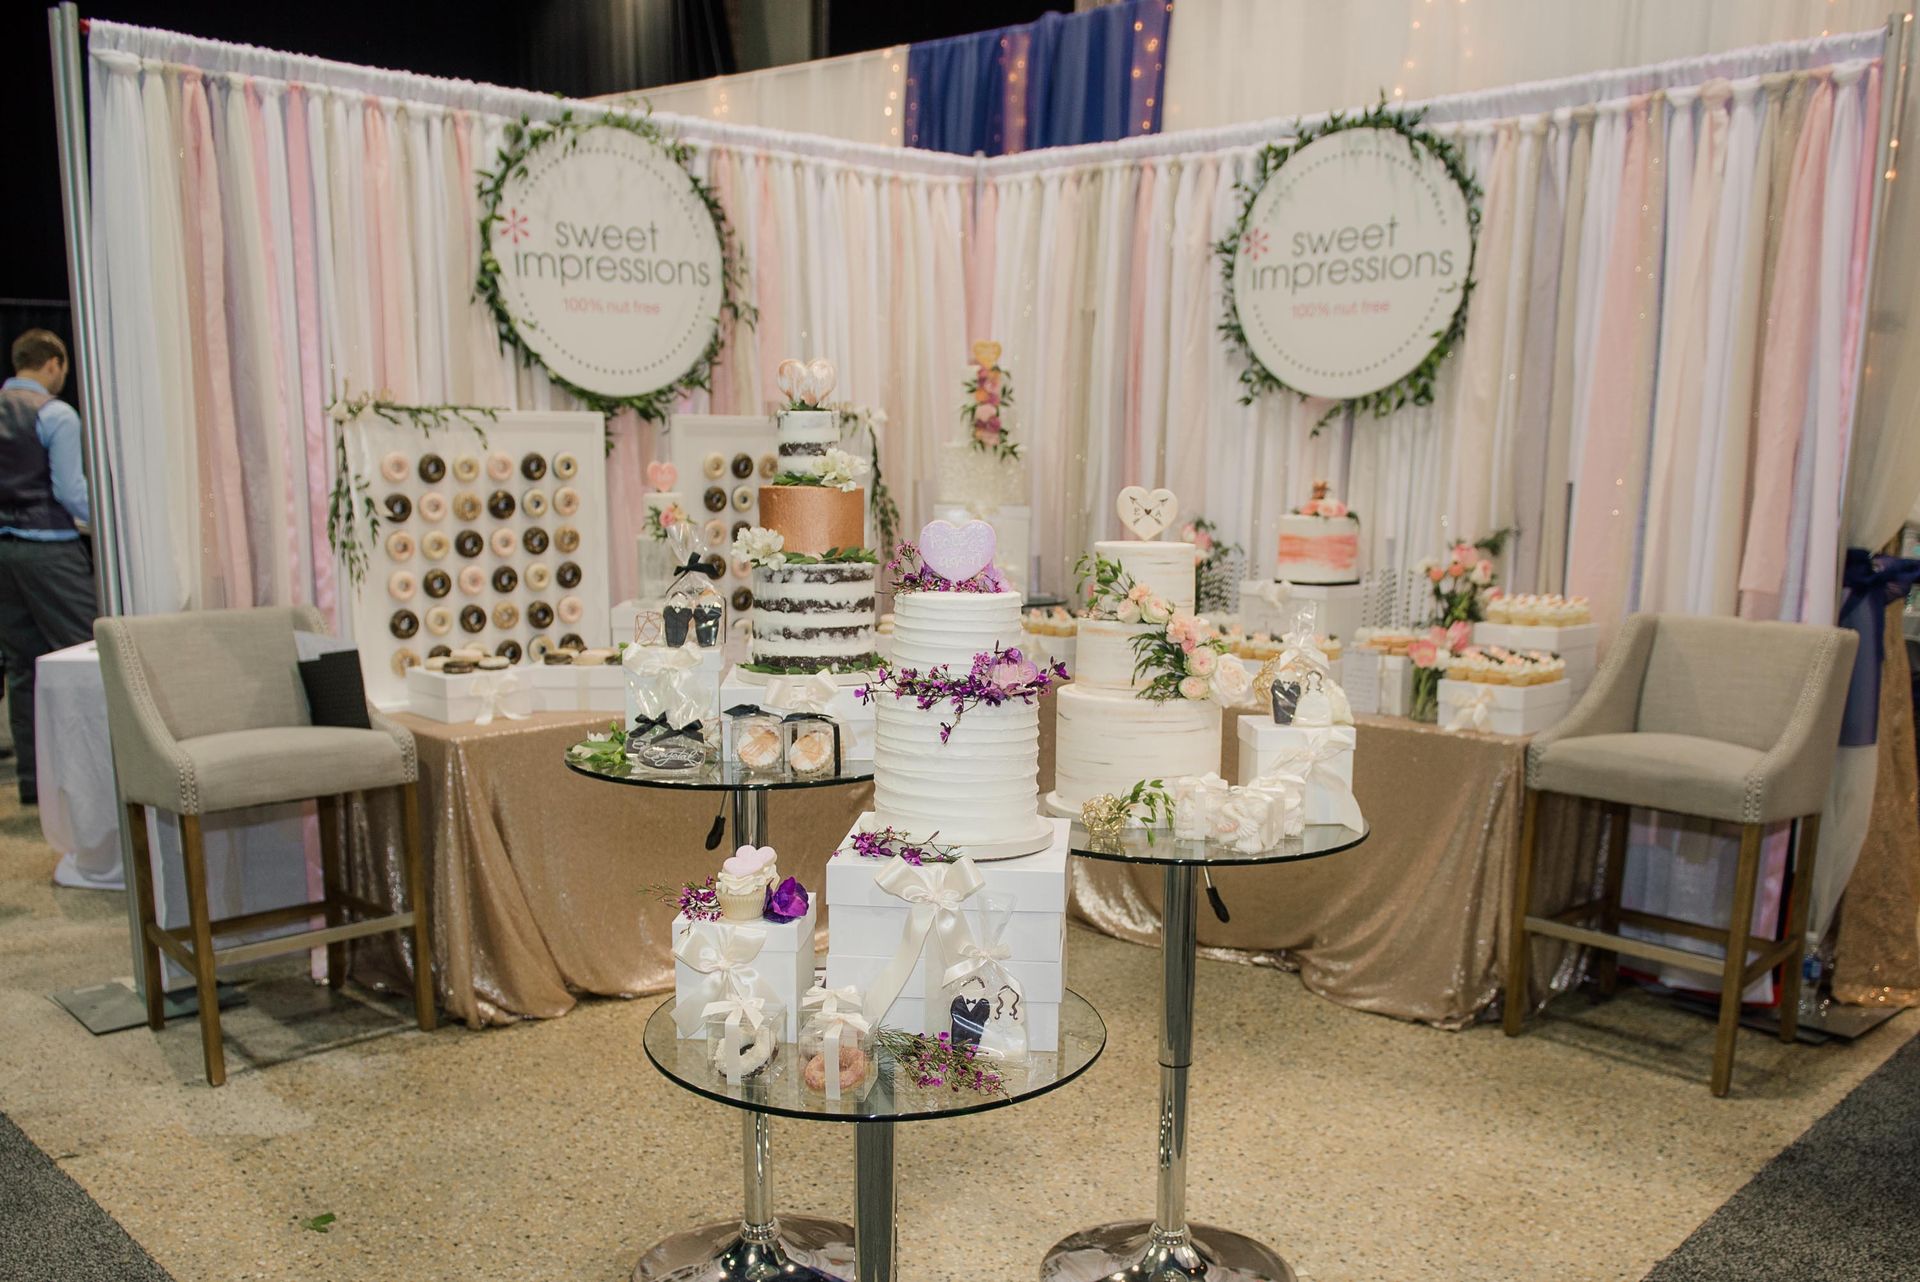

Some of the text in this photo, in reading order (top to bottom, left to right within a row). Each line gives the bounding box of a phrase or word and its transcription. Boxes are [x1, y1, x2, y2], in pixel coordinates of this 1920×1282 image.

[555, 220, 659, 253] sweet
[1291, 216, 1400, 258] sweet
[514, 251, 711, 288] impressions
[1252, 249, 1454, 296] impressions
[563, 297, 661, 315] 100% nut free
[1291, 300, 1390, 319] 100% nut free
